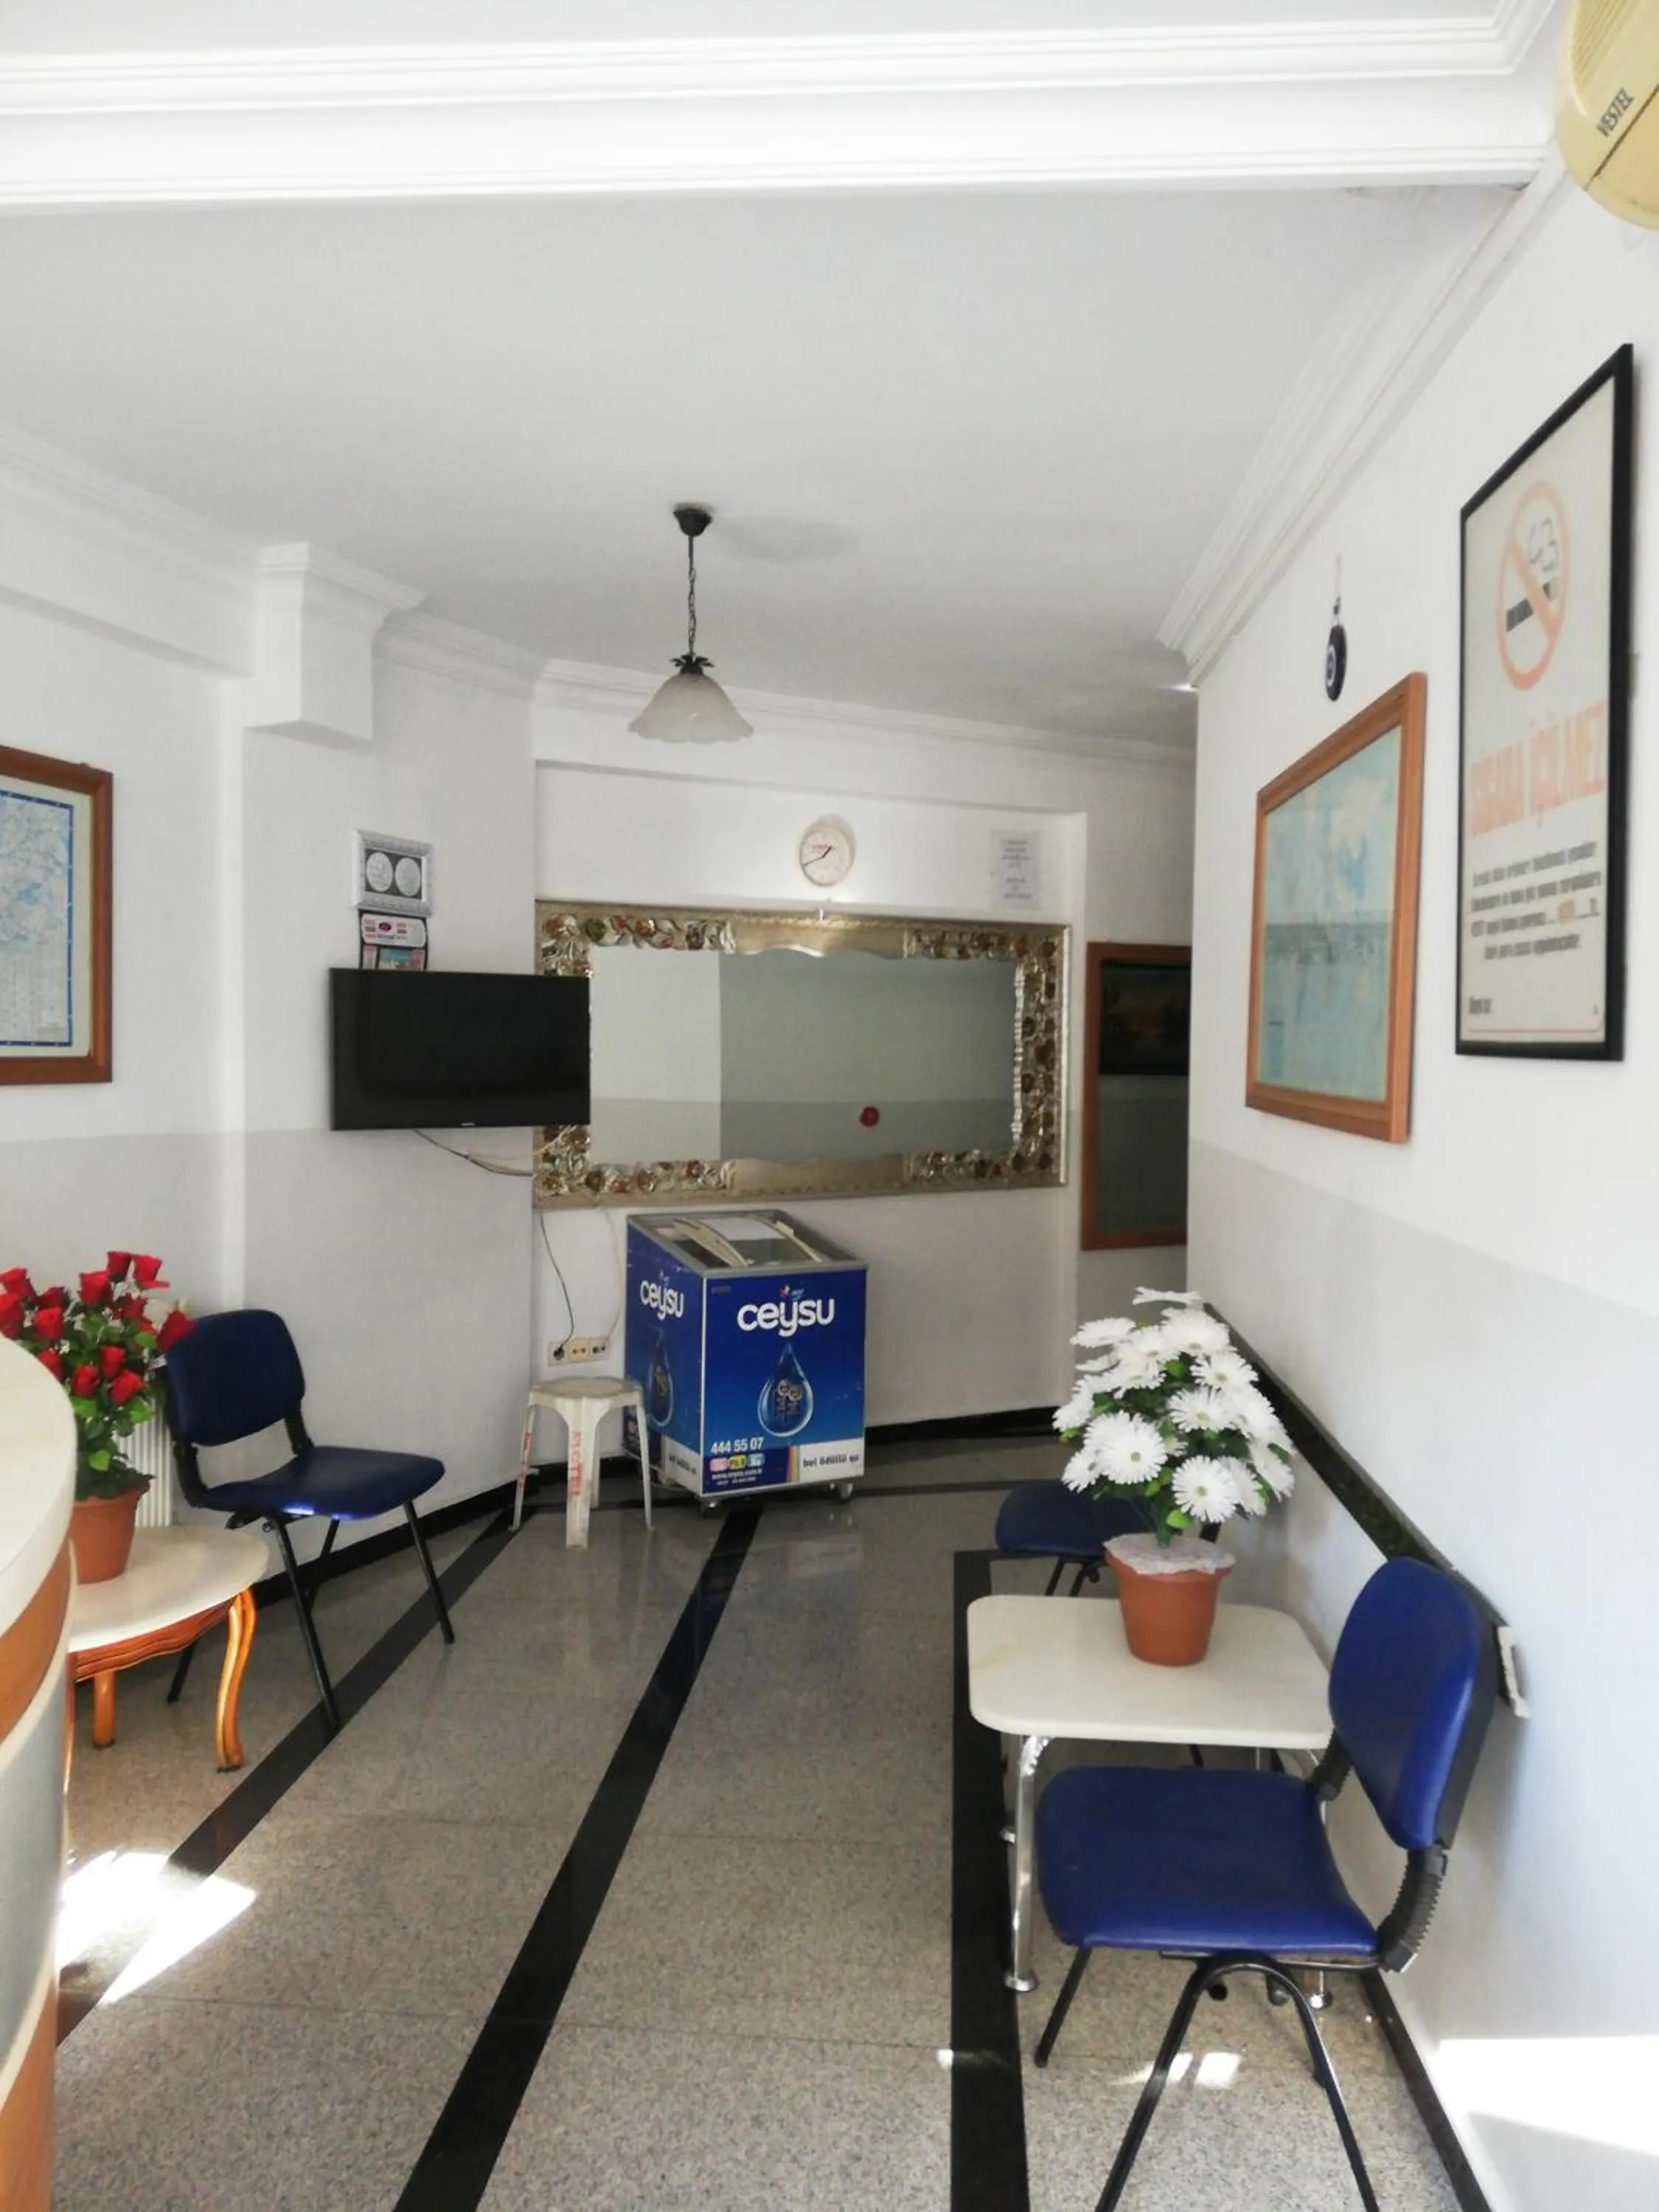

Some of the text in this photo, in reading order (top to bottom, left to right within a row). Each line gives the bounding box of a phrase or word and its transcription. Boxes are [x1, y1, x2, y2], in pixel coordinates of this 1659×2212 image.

[1596, 87, 1634, 137] VESTEL
[639, 1279, 684, 1321] ceysu
[737, 1298, 835, 1338] ceysu
[710, 1436, 765, 1455] 444 55 07
